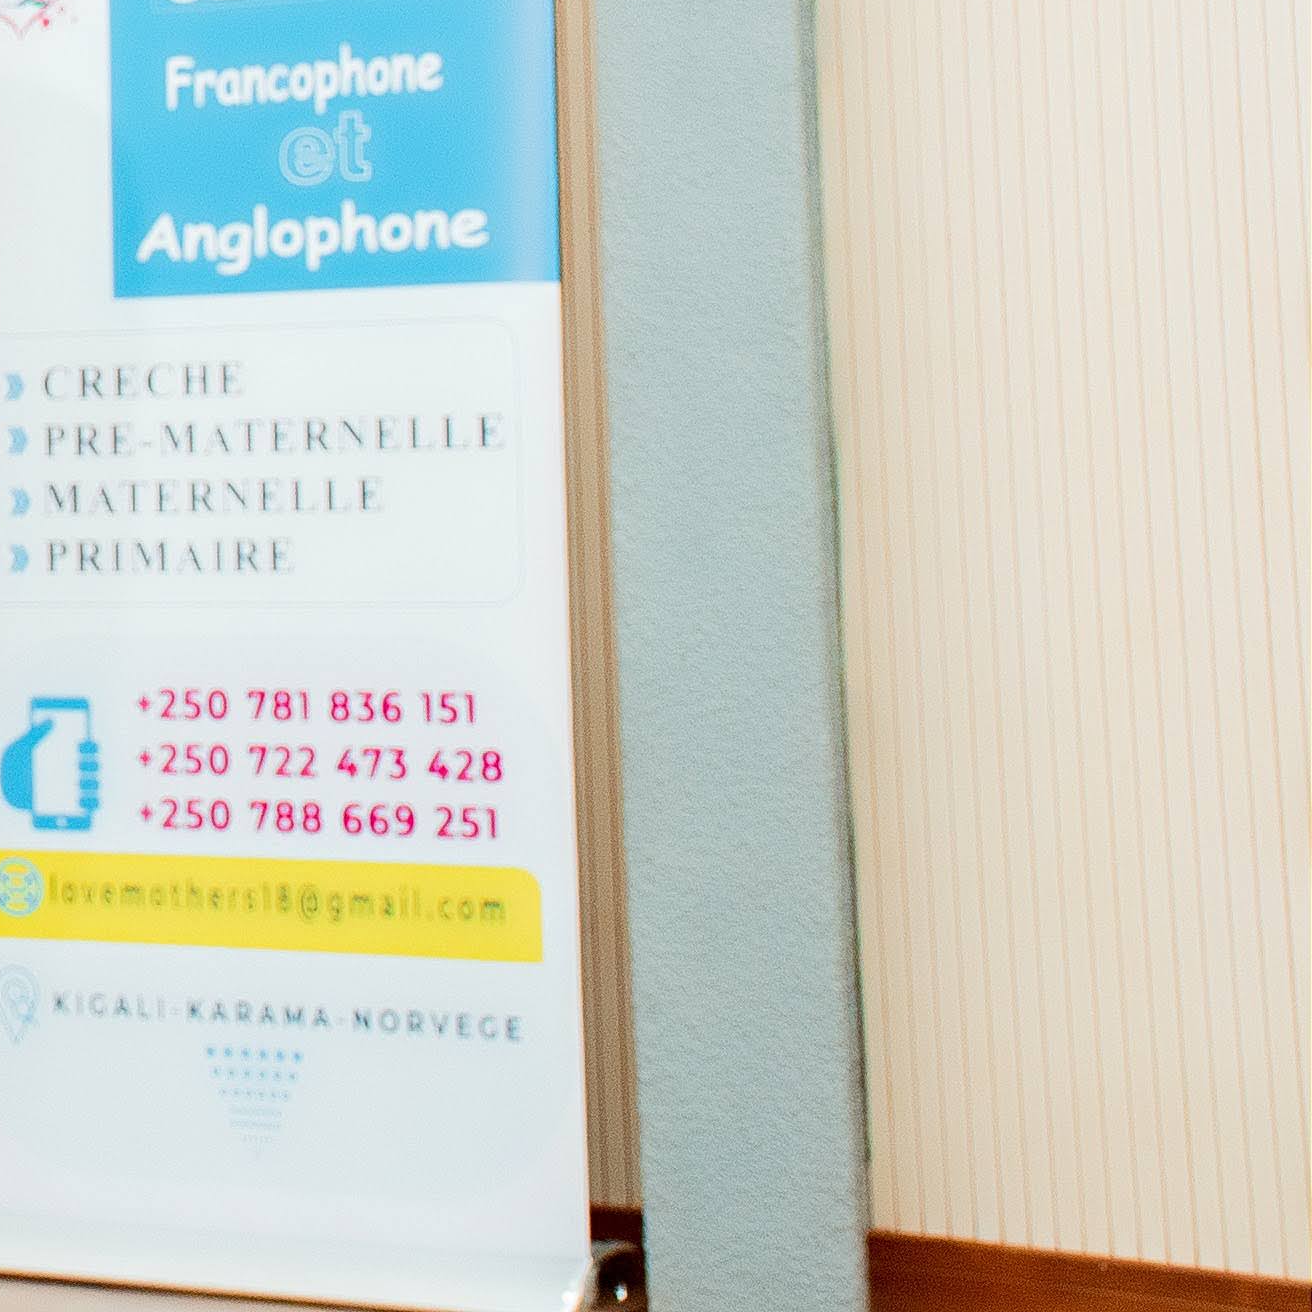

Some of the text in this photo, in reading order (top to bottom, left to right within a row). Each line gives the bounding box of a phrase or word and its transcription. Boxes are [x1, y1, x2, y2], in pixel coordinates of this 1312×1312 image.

[165, 42, 443, 115] Francophone
[278, 109, 374, 186] et
[136, 199, 490, 276] Anglophone
[42, 361, 247, 400] CRECHE
[44, 412, 507, 458] PRE-MATERNELLE
[44, 475, 386, 517] MATERNELLE
[46, 536, 296, 575] PRIMAIRE
[136, 688, 478, 726] +250 781 836 151
[137, 743, 504, 783] +250 722 473 428
[138, 798, 499, 840] +250 788 669 251
[47, 874, 507, 923] lovemothers18@gmail.com
[51, 990, 524, 1044] KIGALI-KARAMA-NORVEGE
